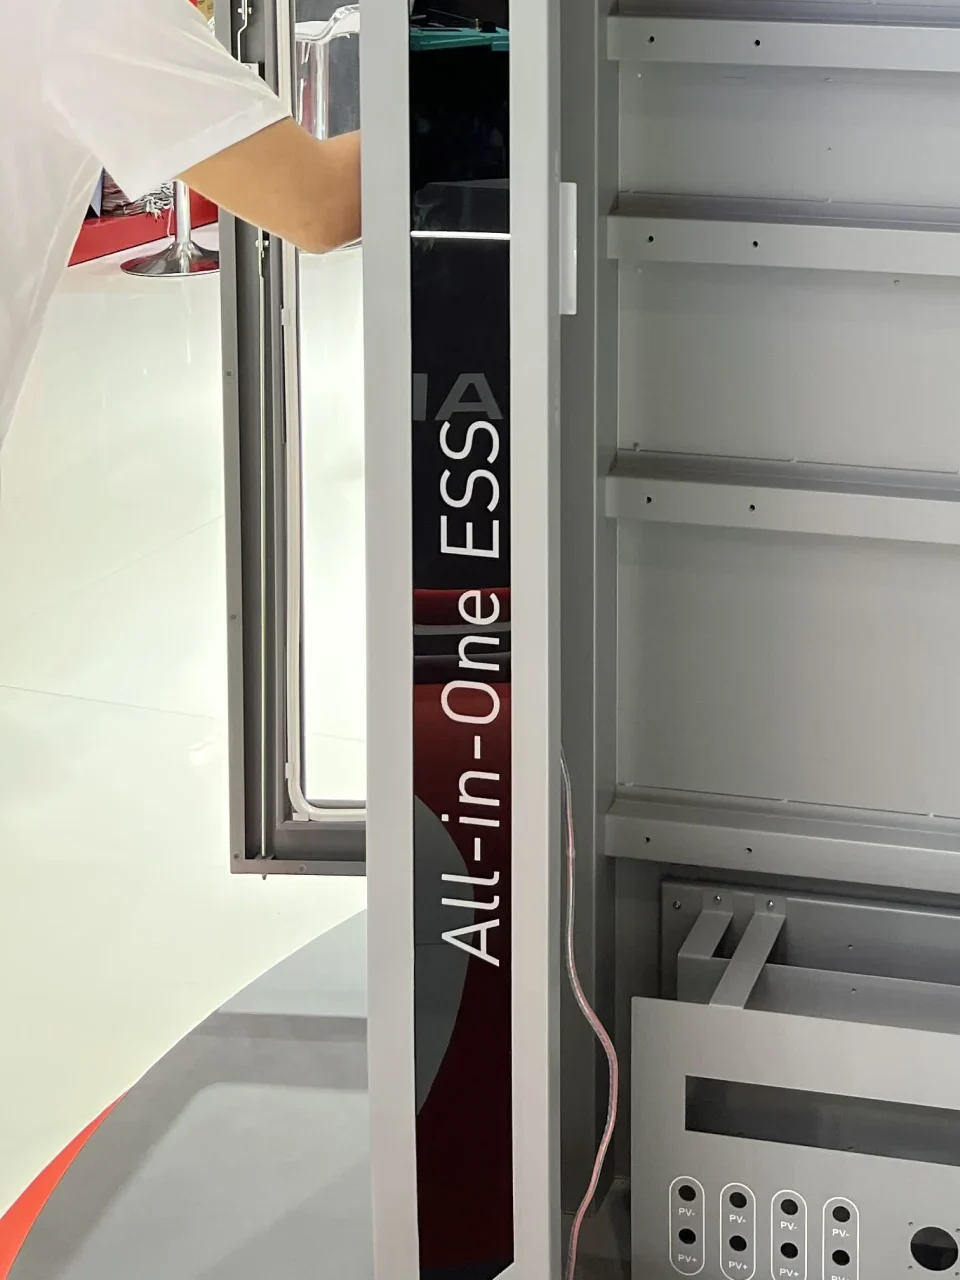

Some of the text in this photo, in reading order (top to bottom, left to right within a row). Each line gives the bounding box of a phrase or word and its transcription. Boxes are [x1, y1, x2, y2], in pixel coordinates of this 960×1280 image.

[439, 419, 500, 968] All-in-One ESS
[678, 1207, 696, 1217] PV-
[729, 1214, 747, 1224] PV-
[780, 1221, 798, 1231] PV-
[832, 1228, 850, 1238] PV-
[678, 1253, 697, 1263] PV+
[728, 1260, 748, 1270] PV+
[779, 1267, 799, 1278] PV+
